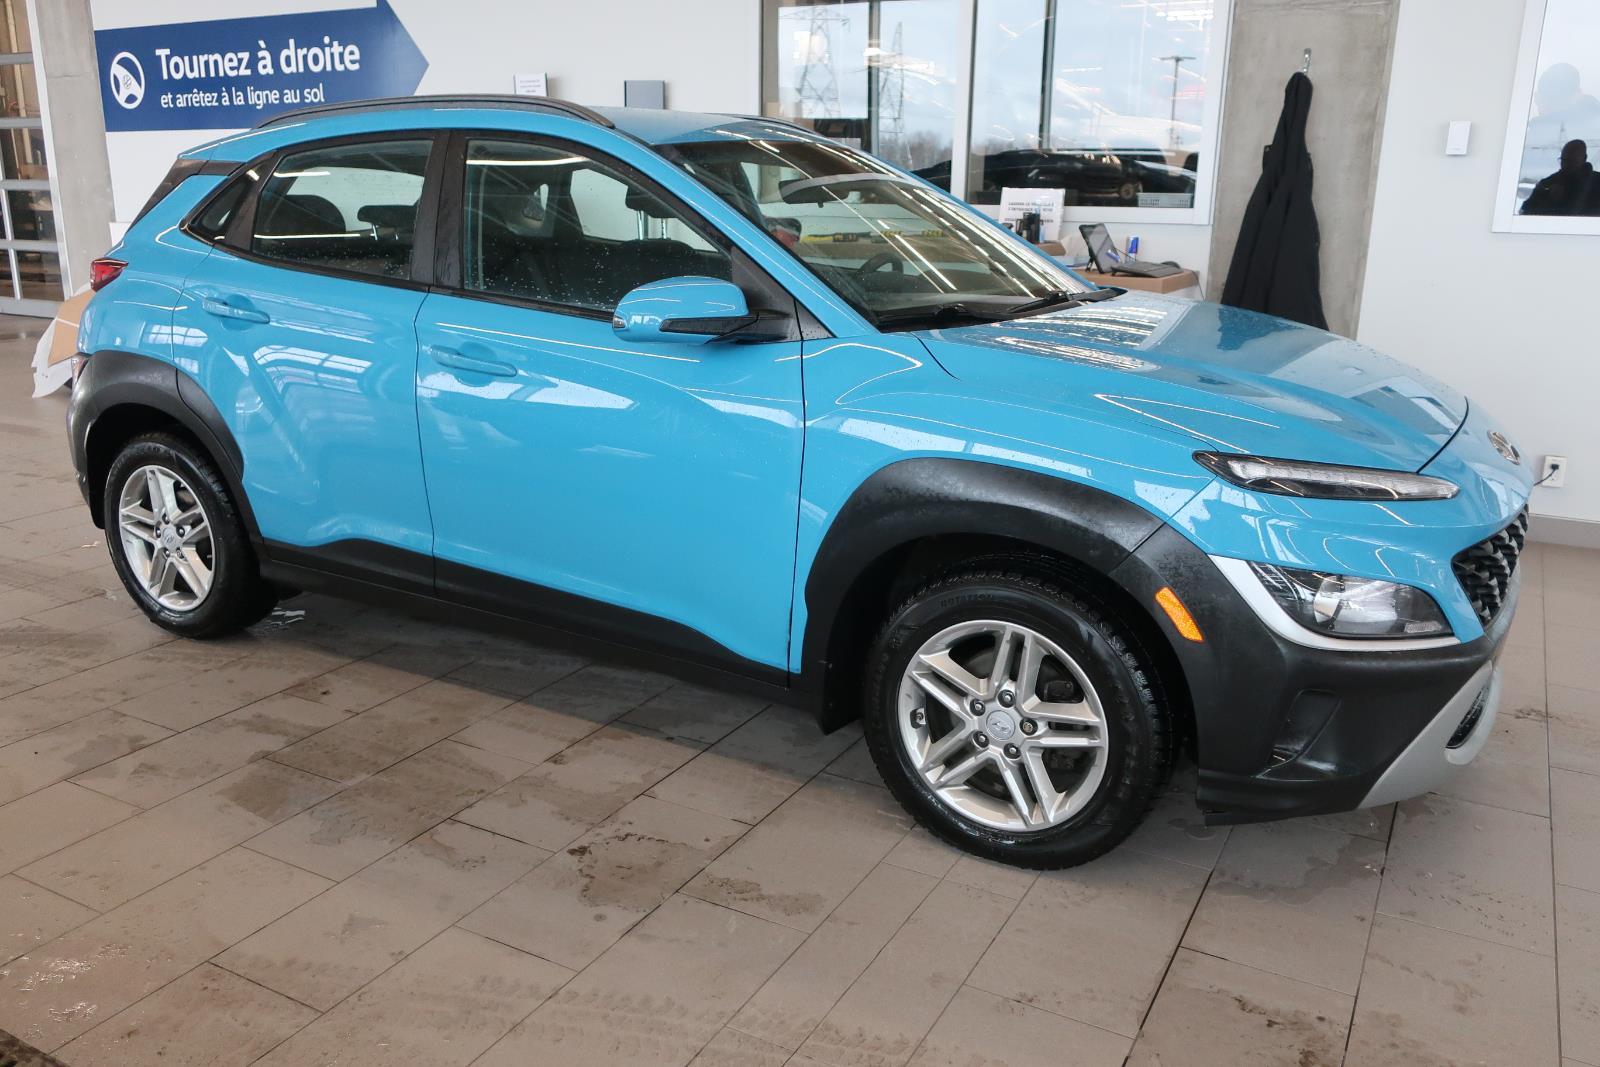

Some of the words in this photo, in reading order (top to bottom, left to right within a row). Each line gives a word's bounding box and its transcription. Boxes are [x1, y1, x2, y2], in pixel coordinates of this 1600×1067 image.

[155, 48, 251, 79] Tournez
[257, 39, 273, 75] à
[279, 35, 360, 73] droite
[160, 92, 173, 107] et
[175, 88, 218, 107] arrêtez
[221, 87, 230, 105] à
[231, 86, 244, 105] la
[247, 86, 279, 109] ligne
[283, 89, 300, 103] au
[303, 82, 324, 102] sol
